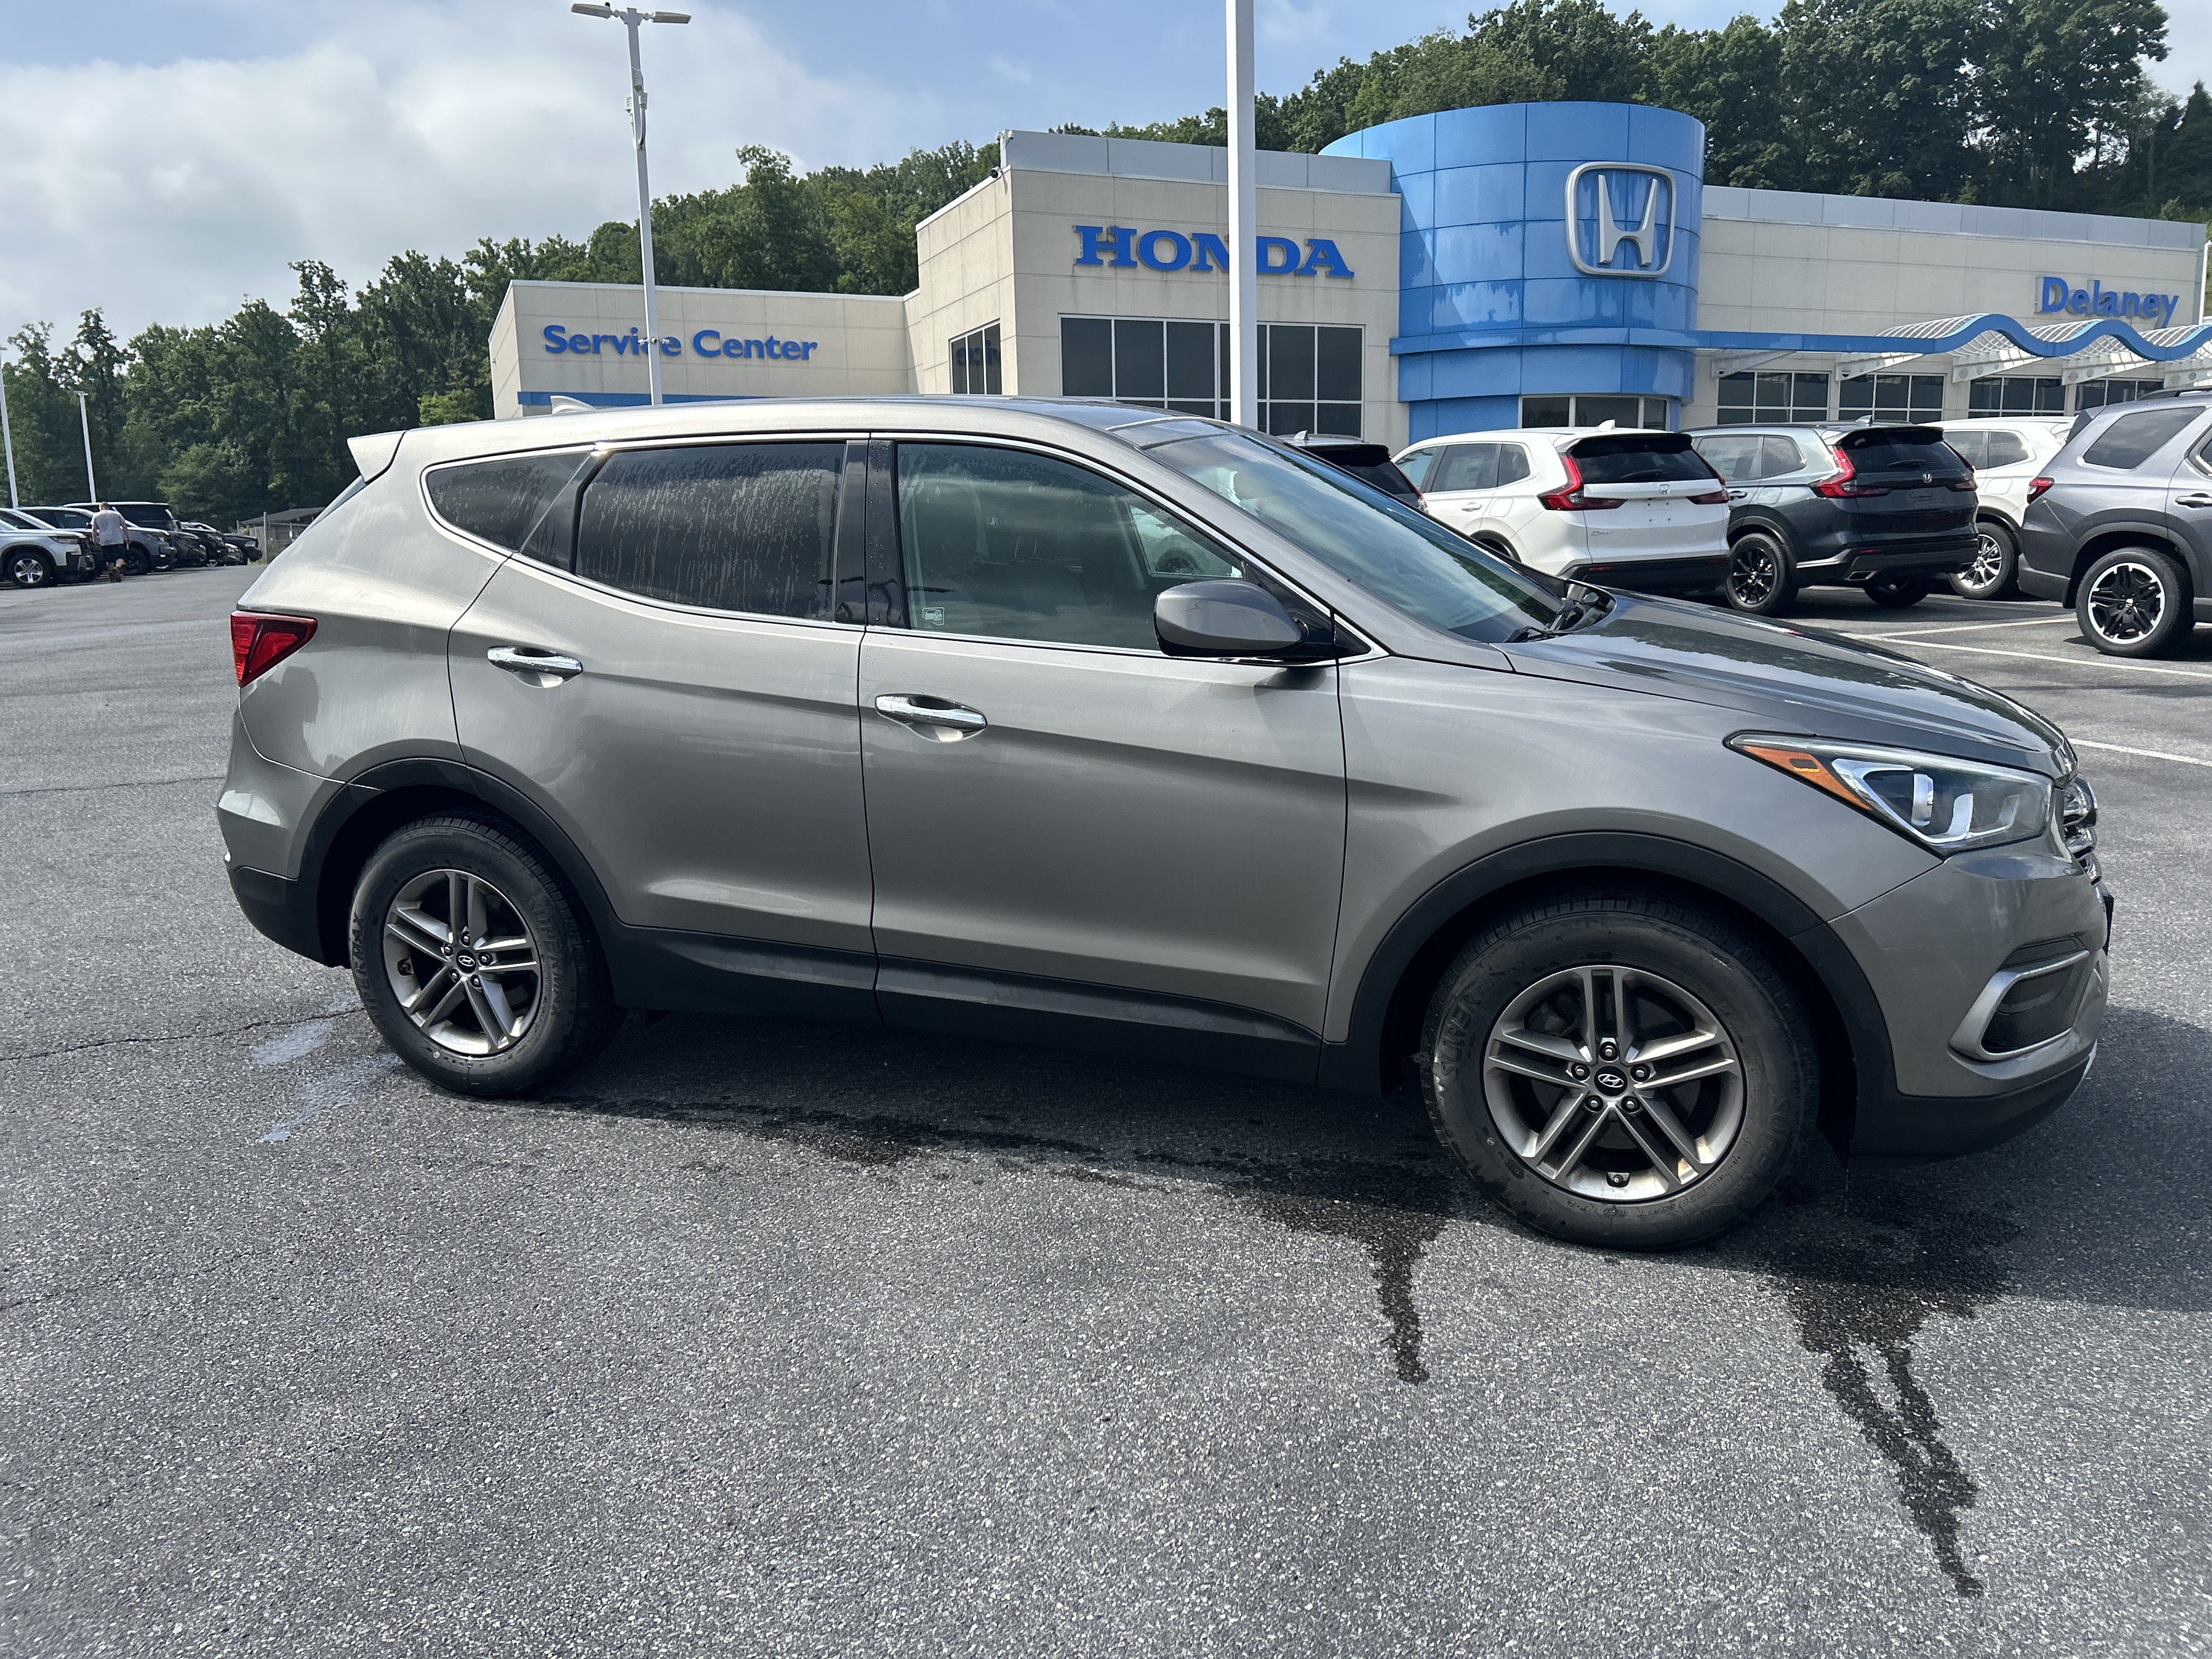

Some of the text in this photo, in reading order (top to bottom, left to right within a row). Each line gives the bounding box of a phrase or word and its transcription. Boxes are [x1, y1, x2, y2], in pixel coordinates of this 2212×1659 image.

[1073, 225, 1355, 278] HONDA
[2037, 276, 2180, 328] Delaney
[693, 329, 818, 360] Center
